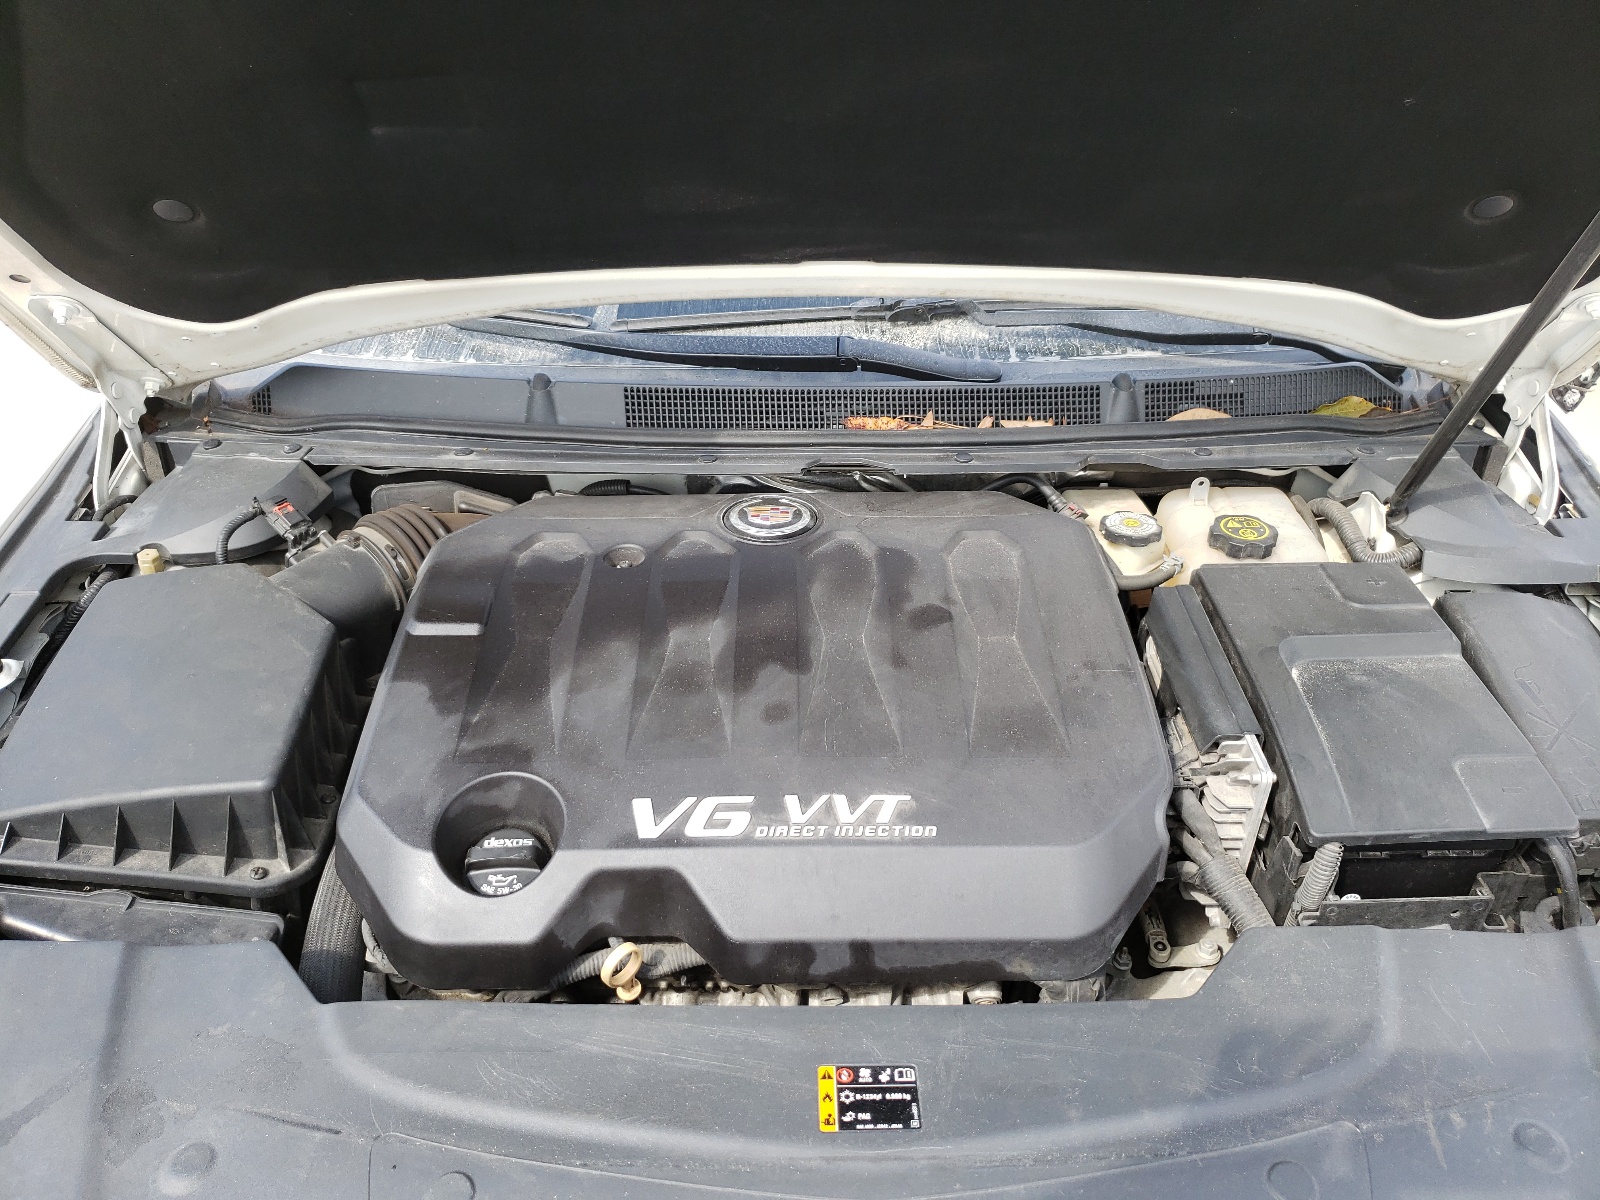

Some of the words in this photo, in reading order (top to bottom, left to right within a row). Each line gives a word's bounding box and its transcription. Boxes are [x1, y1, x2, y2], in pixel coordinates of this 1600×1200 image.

[631, 796, 755, 839] V6
[784, 795, 911, 824] VVT
[755, 825, 828, 837] DIRECT
[834, 825, 937, 837] INJECTION
[483, 837, 534, 848] dexos
[481, 883, 496, 894] SAE
[497, 882, 523, 895] 5W-30
